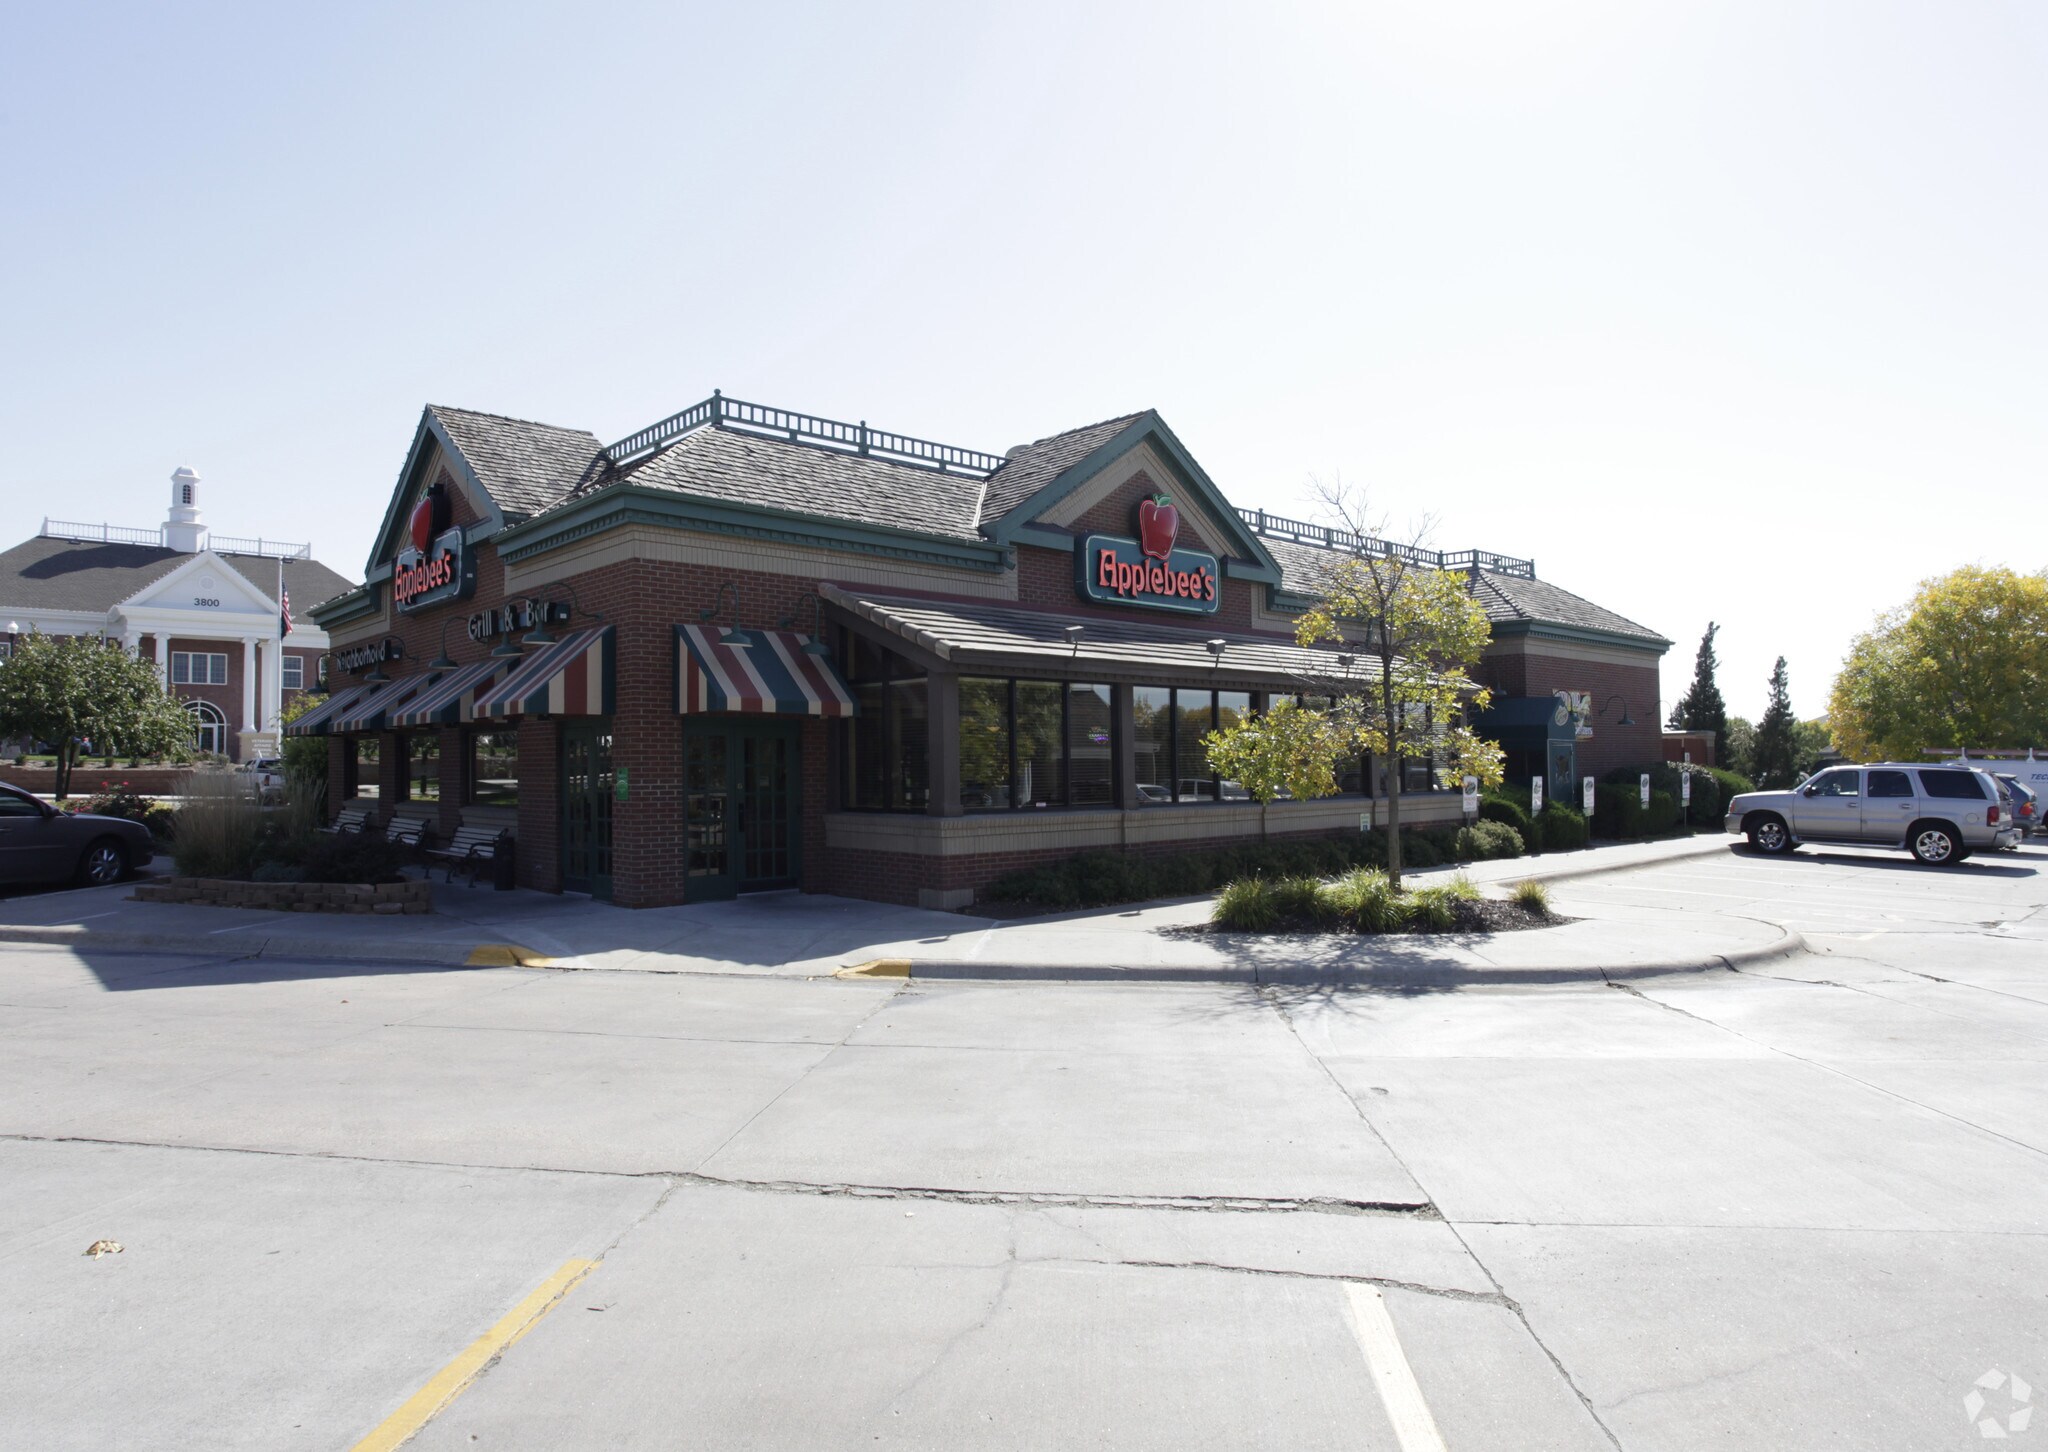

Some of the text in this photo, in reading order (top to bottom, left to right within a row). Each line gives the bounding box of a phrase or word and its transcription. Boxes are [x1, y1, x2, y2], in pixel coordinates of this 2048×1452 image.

[395, 548, 451, 604] Applebee's
[1099, 548, 1214, 601] Applebee's
[193, 597, 220, 607] 3800
[468, 609, 492, 640] Grill
[504, 604, 514, 632] &
[525, 599, 550, 627] Bar
